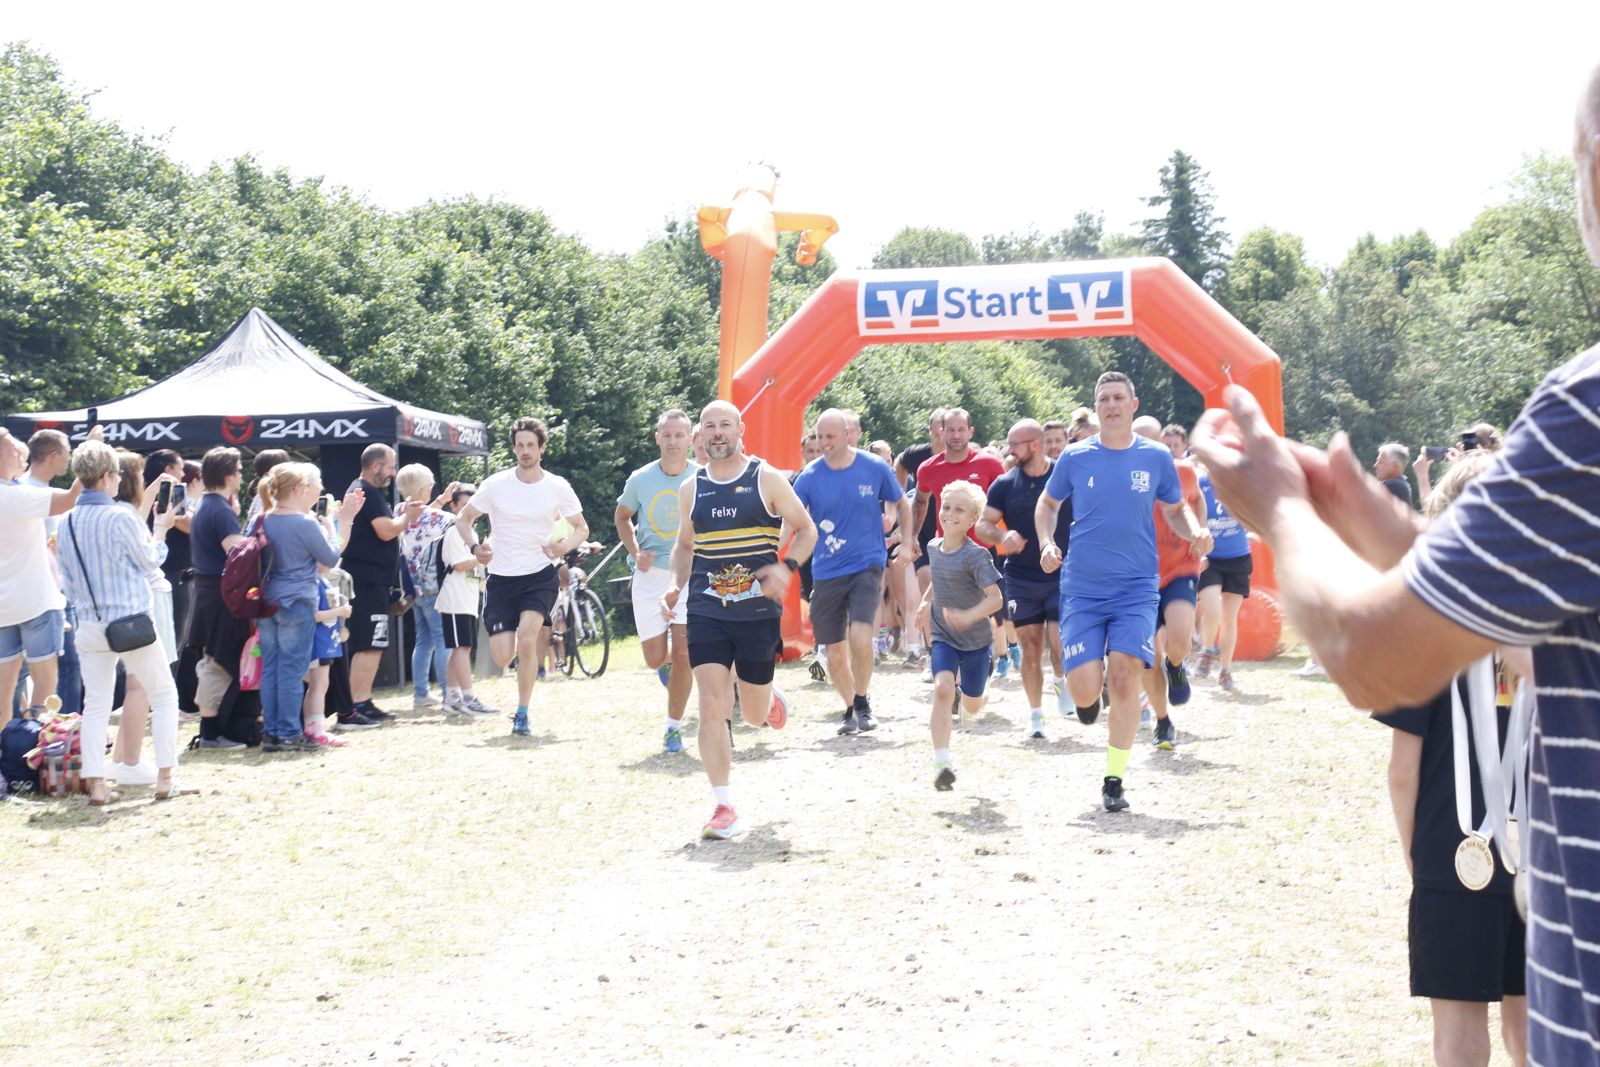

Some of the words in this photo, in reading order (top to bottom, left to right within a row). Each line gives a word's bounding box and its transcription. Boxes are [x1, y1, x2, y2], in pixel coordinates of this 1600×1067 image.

[944, 286, 1042, 318] Start
[70, 421, 182, 441] 24MX
[259, 418, 370, 439] 24MX
[413, 416, 443, 440] 24MX
[1087, 475, 1095, 489] 4
[711, 506, 738, 519] Feixy
[1063, 641, 1086, 661] Max
